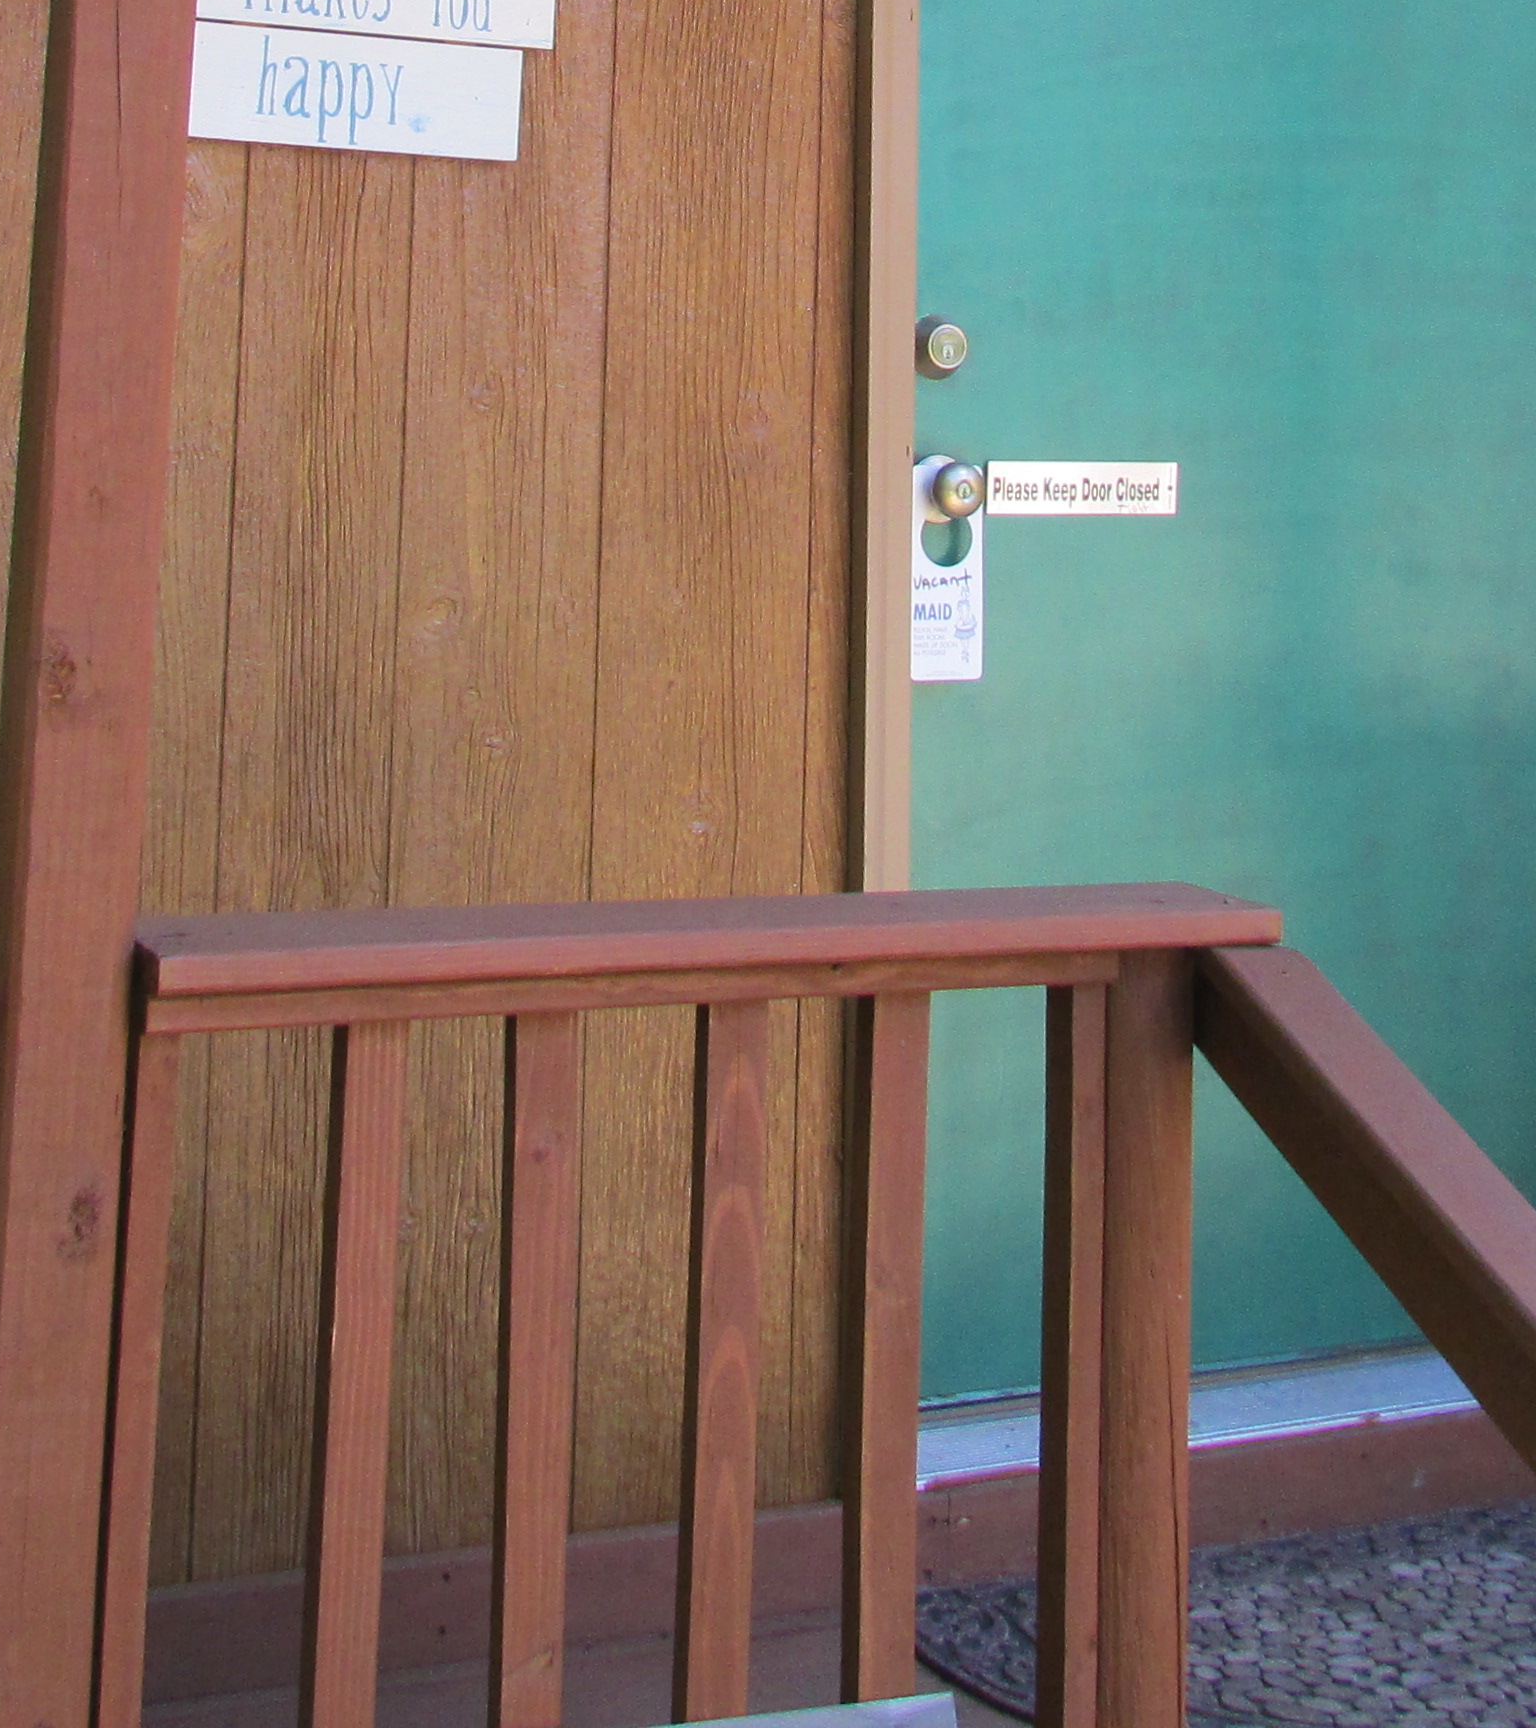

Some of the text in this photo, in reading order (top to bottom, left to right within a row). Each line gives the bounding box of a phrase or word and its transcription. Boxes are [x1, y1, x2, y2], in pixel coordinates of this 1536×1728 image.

[992, 476, 1161, 509] Please Keep Door Closed
[913, 603, 953, 620] MAID
